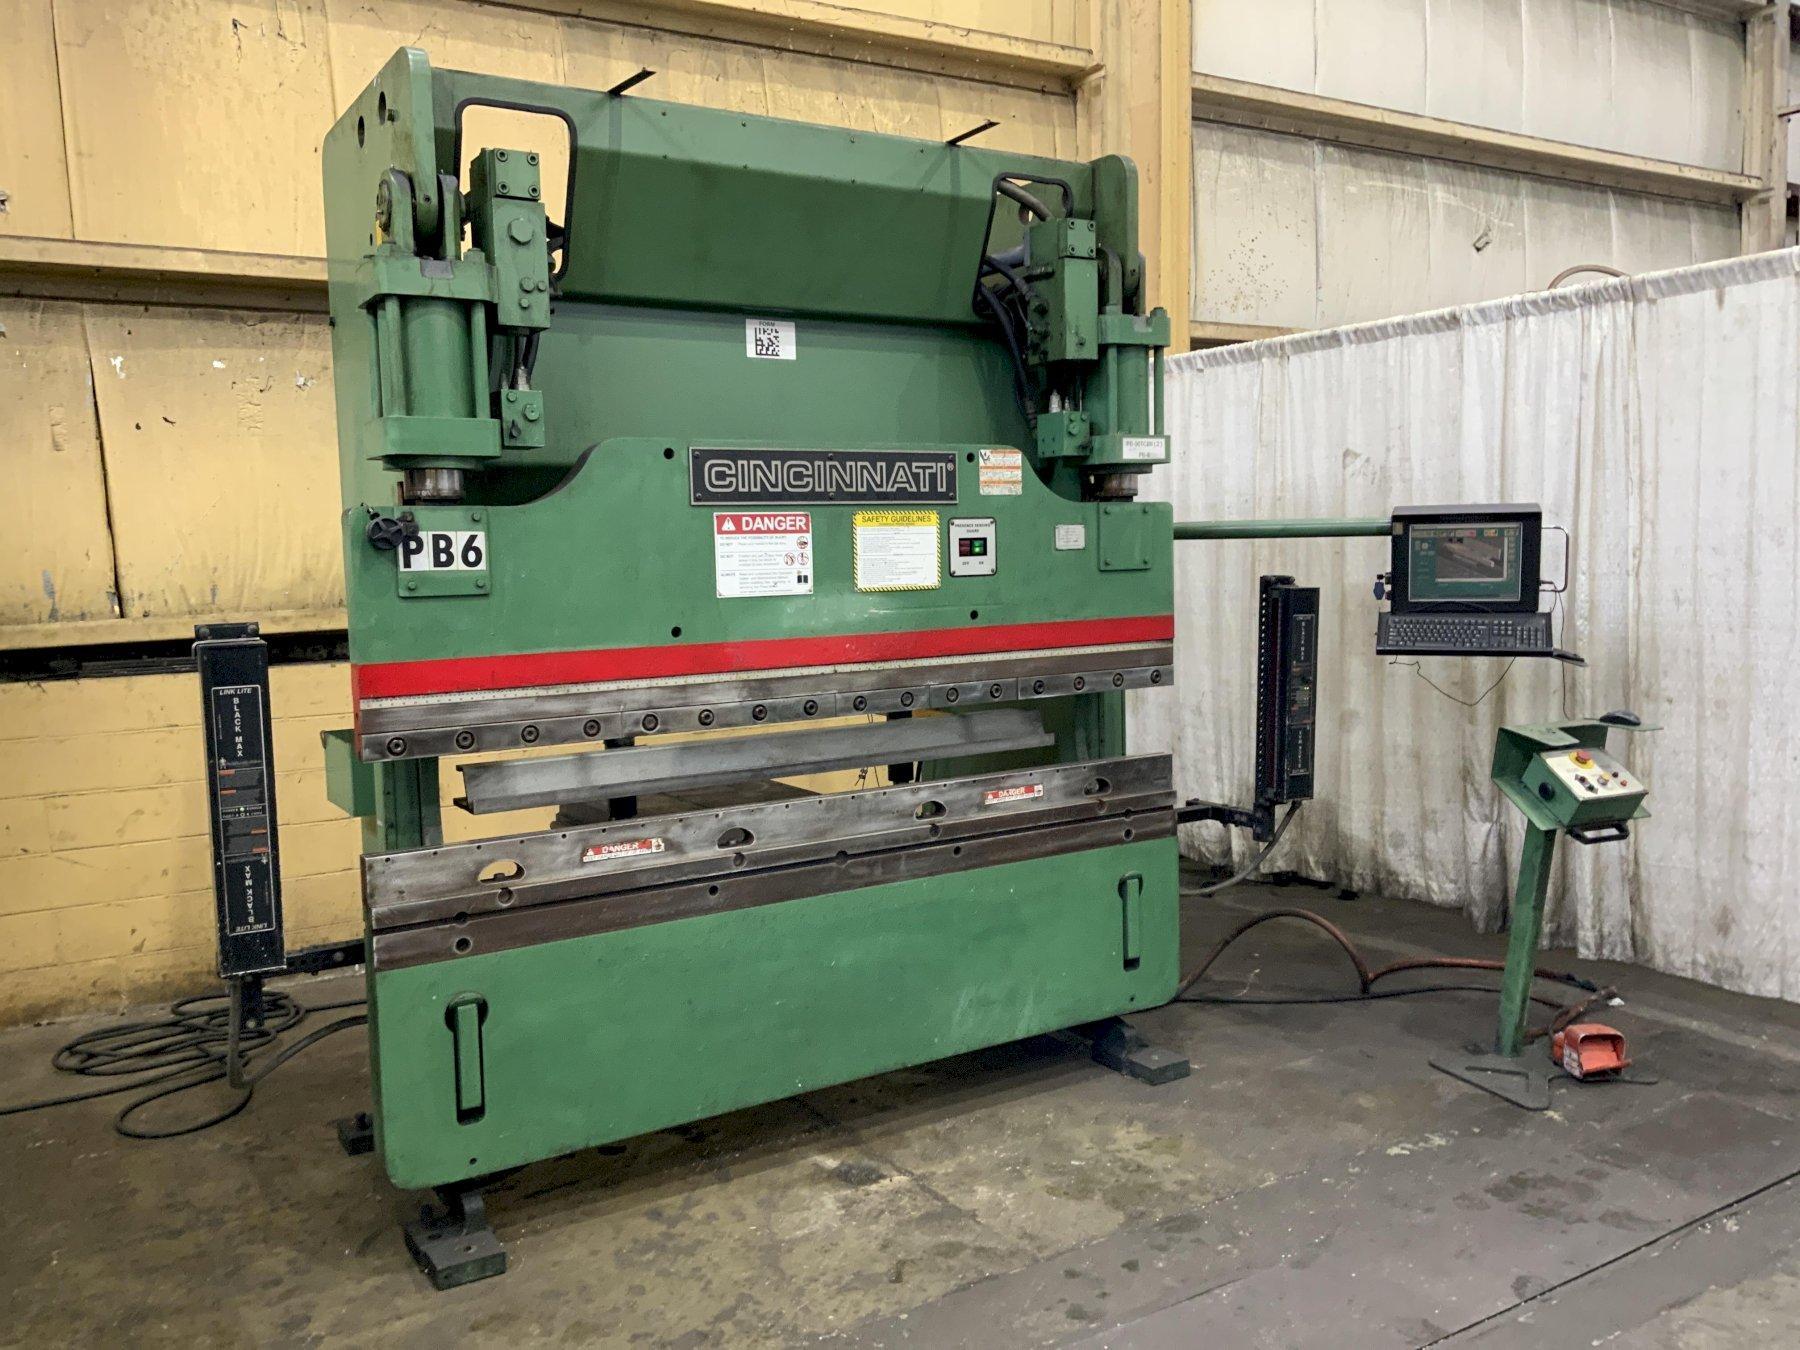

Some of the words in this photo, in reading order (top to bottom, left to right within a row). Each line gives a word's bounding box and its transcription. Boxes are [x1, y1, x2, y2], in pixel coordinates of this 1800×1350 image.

[741, 516, 807, 531] DANGER
[861, 515, 889, 523] SAFETY
[402, 533, 483, 569] PB6
[236, 687, 252, 695] LITE
[232, 697, 242, 733] BLACK
[235, 736, 243, 757] MAX
[998, 786, 1026, 798] DANGER
[601, 842, 639, 853] DANGER
[244, 865, 253, 887] MAX
[246, 888, 255, 923] BLACK
